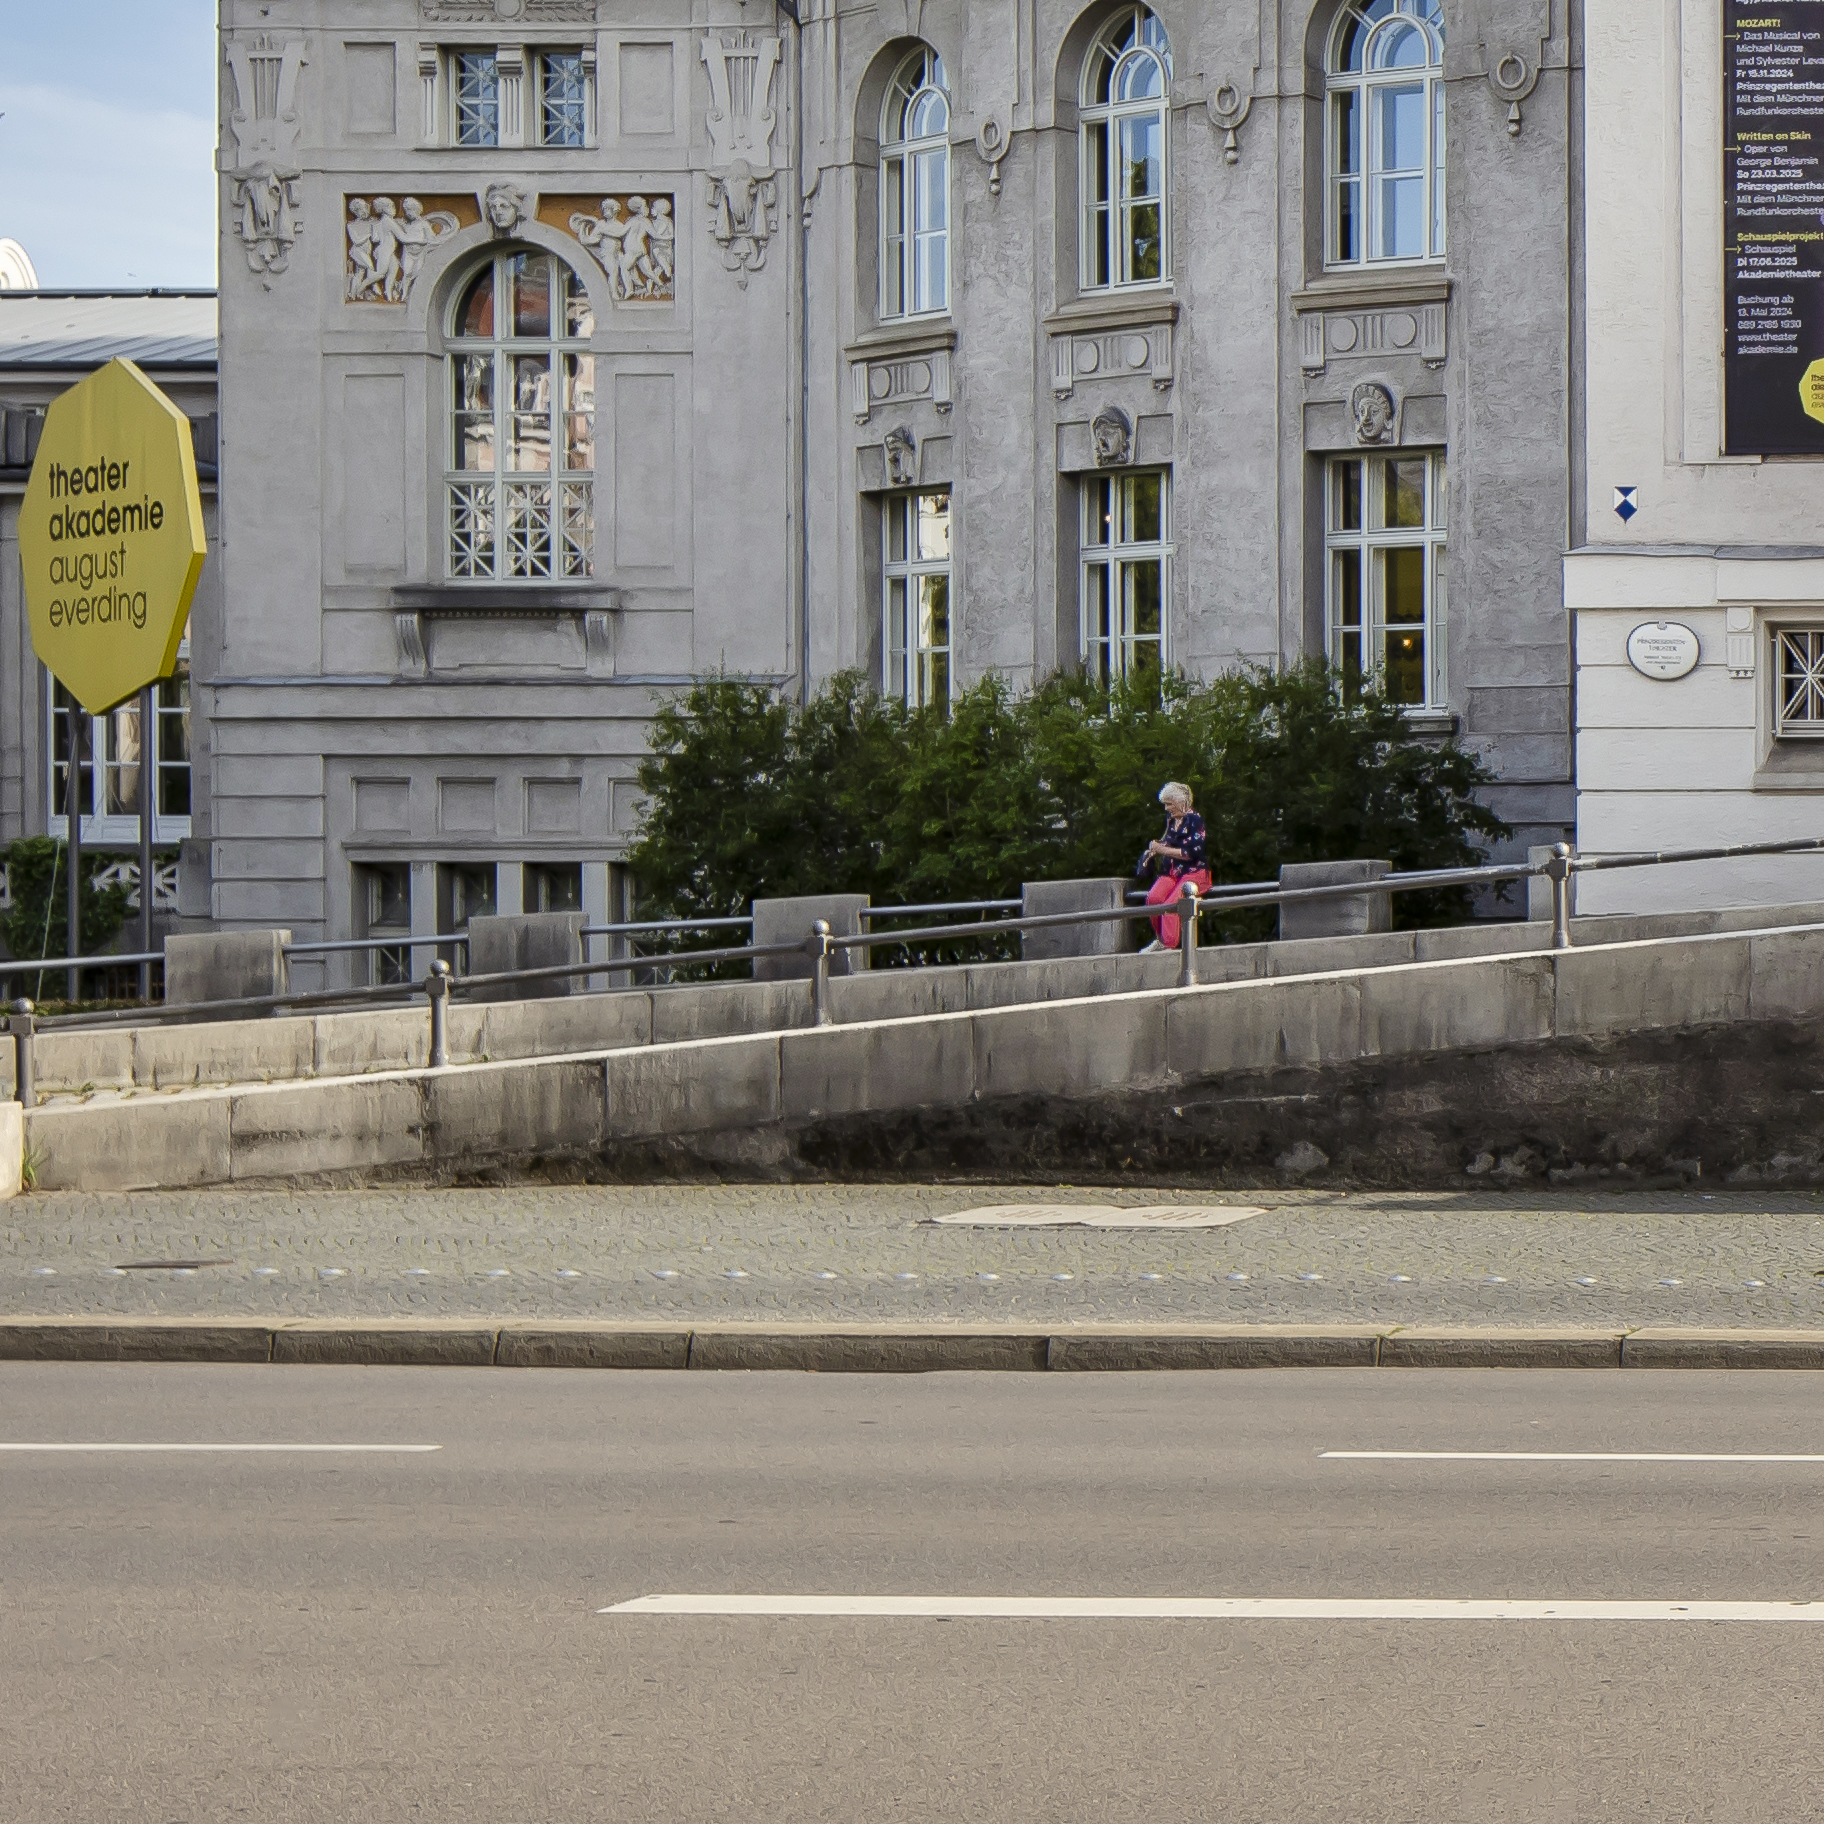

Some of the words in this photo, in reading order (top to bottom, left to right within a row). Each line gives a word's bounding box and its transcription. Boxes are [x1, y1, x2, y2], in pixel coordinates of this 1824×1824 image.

[1743, 31, 1762, 40] Das
[1763, 31, 1800, 40] Musical
[1736, 43, 1773, 52] Michael
[1736, 56, 1754, 65] und
[1755, 56, 1800, 67] Sylvester
[1735, 69, 1746, 78] Fr
[1752, 94, 1774, 103] dem
[1736, 131, 1774, 141] Written
[1790, 131, 1812, 140] Skin
[1744, 144, 1768, 154] Oper
[1736, 157, 1772, 167] George
[1773, 156, 1819, 166] Benjamin
[1737, 231, 1824, 242] Schauspielprojekt
[1744, 244, 1797, 255] Schauspiel
[1736, 257, 1748, 266] Di
[1736, 268, 1822, 278] Akademietheater
[1738, 295, 1780, 305] Buchung
[1781, 294, 1795, 304] ab
[49, 456, 129, 499] theater
[49, 494, 163, 541] akademie
[49, 541, 126, 591] august
[49, 585, 147, 629] everding
